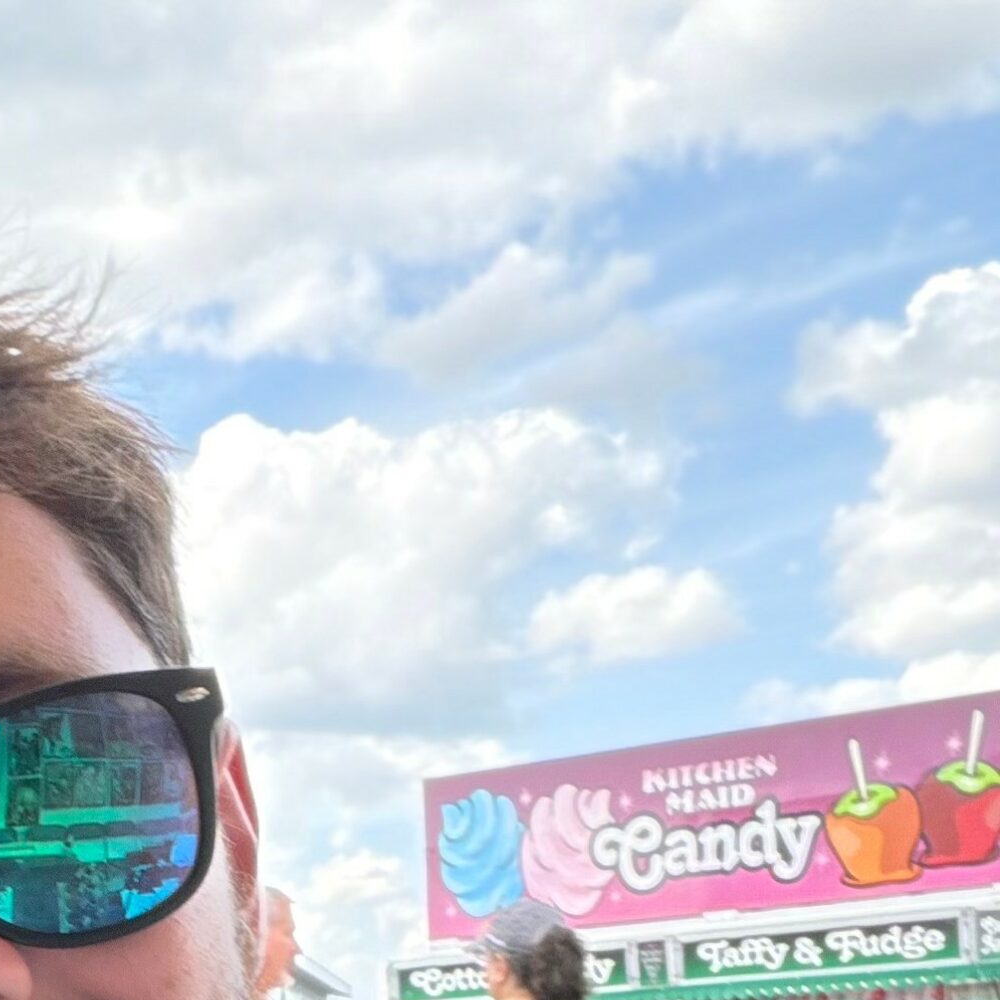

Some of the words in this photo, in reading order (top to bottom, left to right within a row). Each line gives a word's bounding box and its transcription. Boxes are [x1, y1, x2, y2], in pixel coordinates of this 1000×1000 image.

[641, 753, 779, 794] KITCHEN
[664, 783, 757, 816] MAID
[592, 798, 823, 893] Candy
[697, 938, 790, 973] Taffy
[793, 936, 823, 967] &
[825, 924, 947, 963] Fudge
